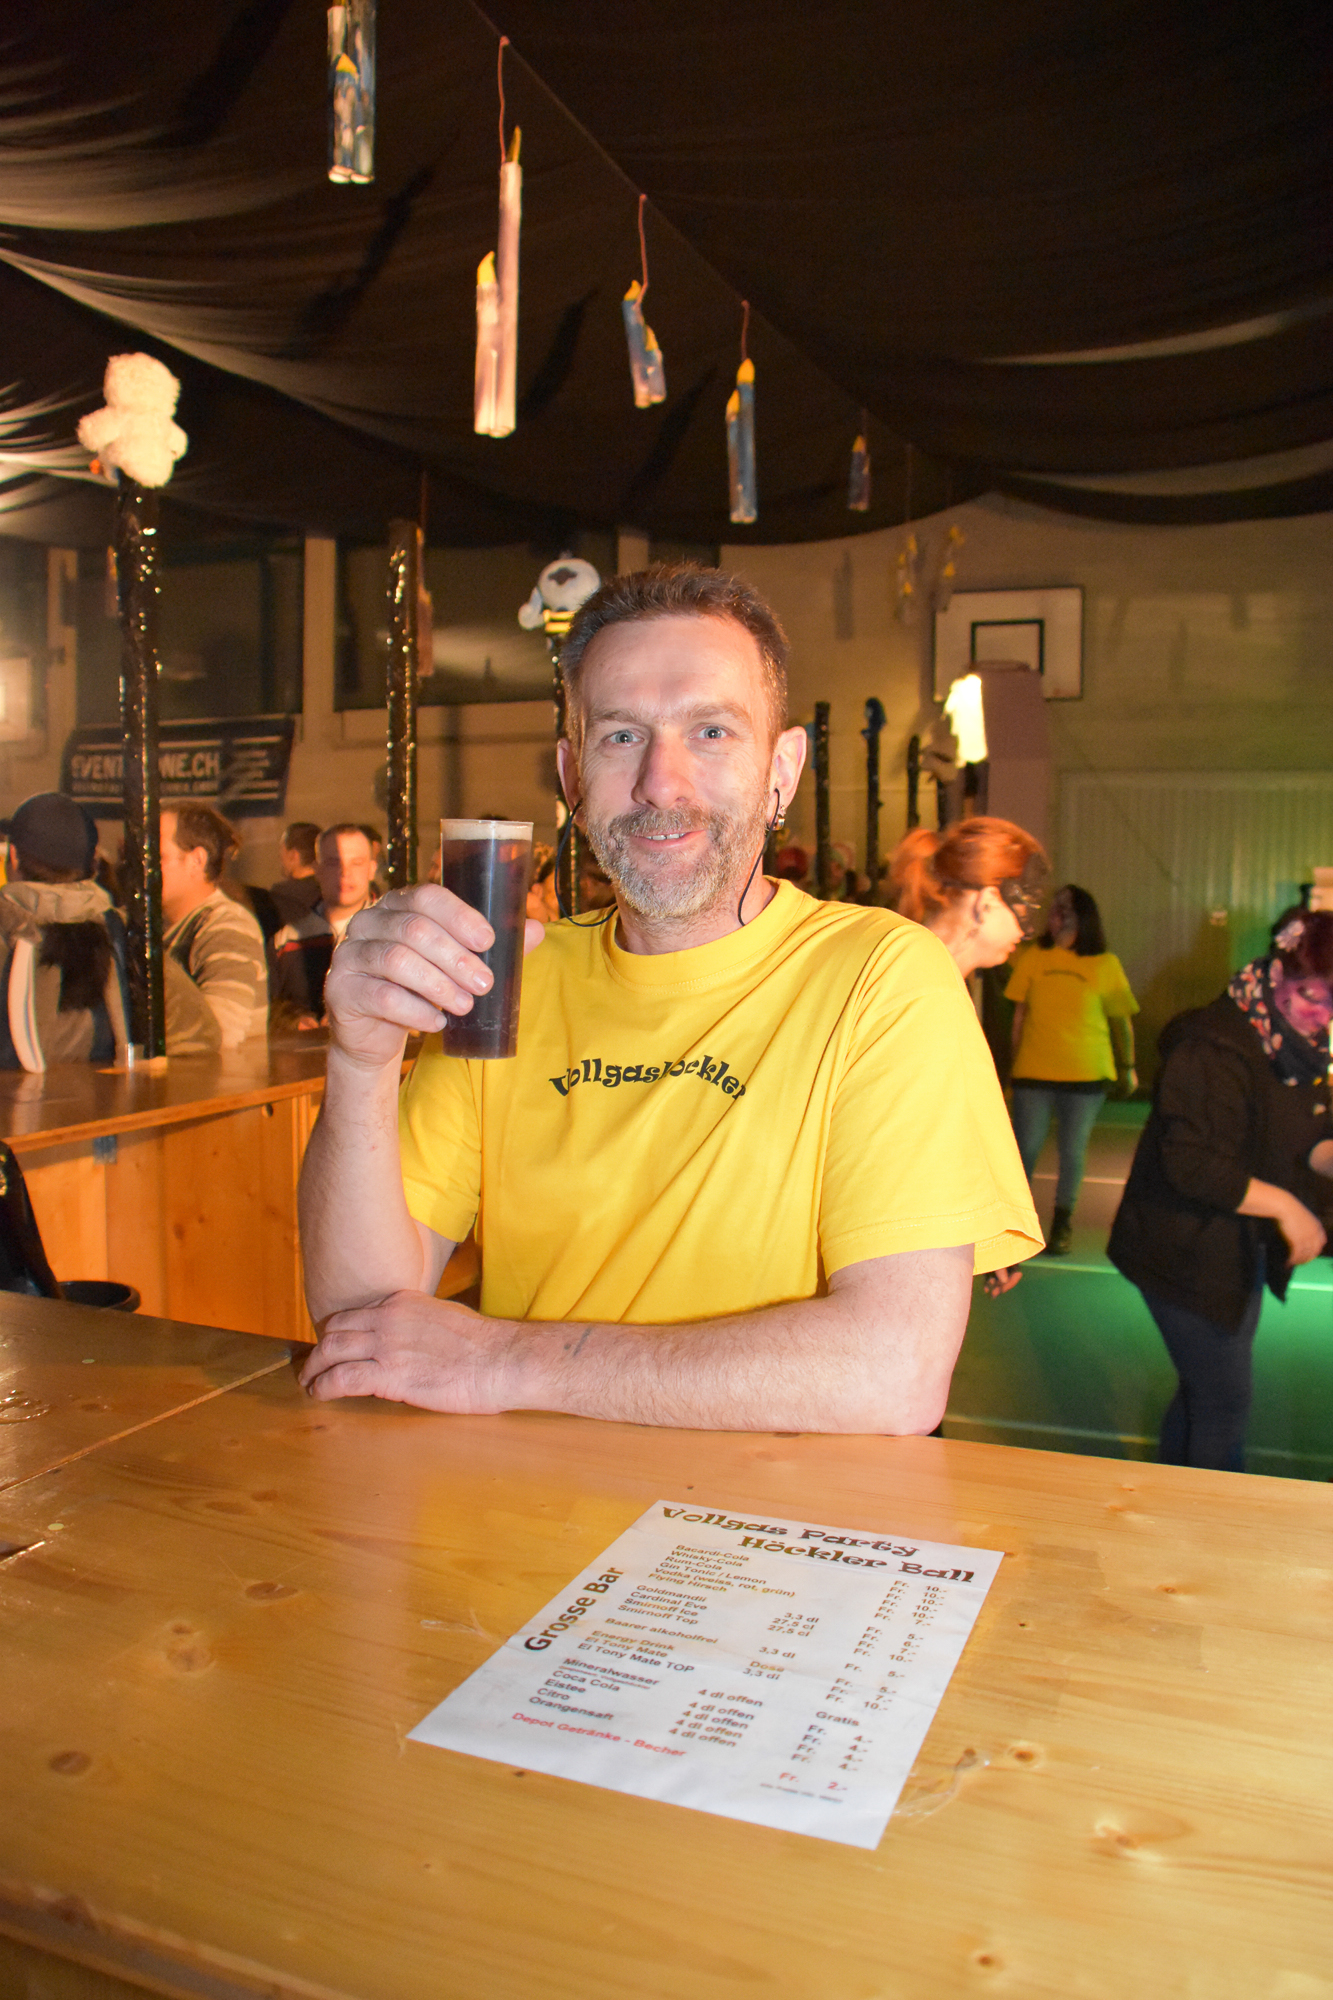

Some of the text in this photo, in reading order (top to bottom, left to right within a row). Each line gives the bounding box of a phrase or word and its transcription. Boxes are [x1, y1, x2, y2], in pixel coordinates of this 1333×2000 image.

[663, 1507, 920, 1557] Vollgas Party
[659, 1562, 680, 1570] Gin
[684, 1566, 716, 1577] Tonic
[725, 1573, 767, 1585] Lemon
[881, 1599, 898, 1607] Fr.
[665, 1556, 722, 1570] Rum-Cola
[671, 1550, 743, 1567] Whisky-Cola
[889, 1586, 906, 1594] Fr.
[675, 1544, 750, 1561] Bacardi-Cola
[893, 1580, 909, 1588] Fr.
[737, 1535, 975, 1583] Höckler Ball
[524, 1567, 624, 1652] Grosse Bar
[630, 1591, 682, 1606] Cardinal
[684, 1601, 708, 1610] Eve
[862, 1633, 879, 1642] Fr.
[648, 1573, 685, 1585] Flying
[687, 1580, 727, 1592] Hirsch
[874, 1612, 891, 1621] Fr.
[654, 1567, 691, 1579] Vodka
[693, 1574, 734, 1588] (weiss,
[738, 1583, 758, 1592] rot,
[761, 1587, 796, 1598] grün)
[878, 1606, 895, 1614] Fr.
[605, 1618, 648, 1631] Baarer
[649, 1626, 718, 1644] alkoholfrei
[844, 1663, 862, 1672] Fr.
[618, 1604, 672, 1619] Smirnoff
[674, 1615, 699, 1625] Top
[853, 1648, 871, 1656] Fr.
[624, 1598, 678, 1612] Smirnoff
[680, 1608, 698, 1616] Ice
[857, 1640, 875, 1649] Fr.
[865, 1626, 883, 1635] Fr.
[591, 1630, 638, 1644] Energy
[640, 1639, 675, 1651] Drink
[750, 1661, 785, 1672] Dose
[835, 1678, 853, 1687] Fr.
[595, 1646, 627, 1659] Tony
[629, 1653, 662, 1666] Mate
[666, 1661, 695, 1672] TOP
[825, 1694, 844, 1703] Fr.
[602, 1639, 634, 1652] Tony
[636, 1646, 668, 1658] Mate
[830, 1686, 849, 1695] Fr.
[544, 1678, 587, 1694] Eistee
[711, 1717, 749, 1729] offen
[802, 1734, 821, 1745] Fr.
[552, 1669, 587, 1683] Coca
[589, 1678, 620, 1692] Cola
[717, 1708, 755, 1720] offen
[807, 1724, 827, 1735] Fr.
[562, 1657, 660, 1686] Mineralwasser
[726, 1695, 763, 1707] offen
[815, 1711, 860, 1726] Gratis
[529, 1696, 614, 1721] Orangensaft
[698, 1734, 737, 1747] offen
[791, 1753, 811, 1763] Fr.
[536, 1687, 570, 1701] Citro
[704, 1726, 743, 1739] offen
[797, 1744, 816, 1754] Fr.
[512, 1712, 554, 1729] Depot
[556, 1723, 621, 1742] Getränke
[633, 1739, 687, 1757] Becher
[779, 1772, 799, 1783] Fr.
